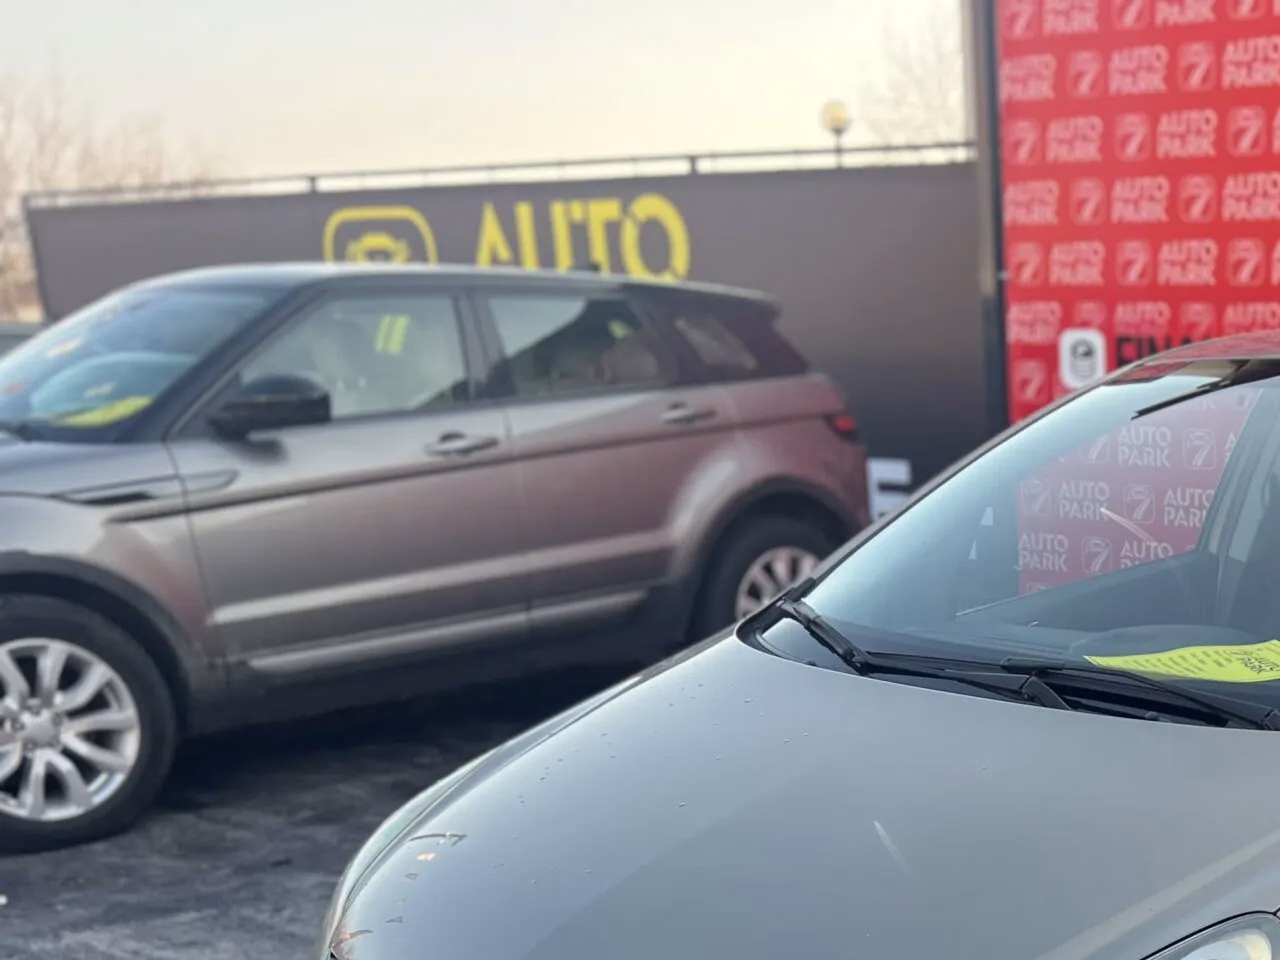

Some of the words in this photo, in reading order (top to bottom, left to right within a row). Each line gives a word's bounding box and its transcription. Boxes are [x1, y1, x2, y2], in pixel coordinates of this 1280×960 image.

[475, 193, 691, 283] AUTO
[1118, 426, 1171, 446] AUTO
[1117, 447, 1171, 468] PARK
[1058, 480, 1110, 501] AUTO
[1058, 501, 1111, 521] PARK
[1018, 532, 1068, 553] AUTO
[1119, 540, 1173, 561] AUTO
[1017, 551, 1068, 573] PARK
